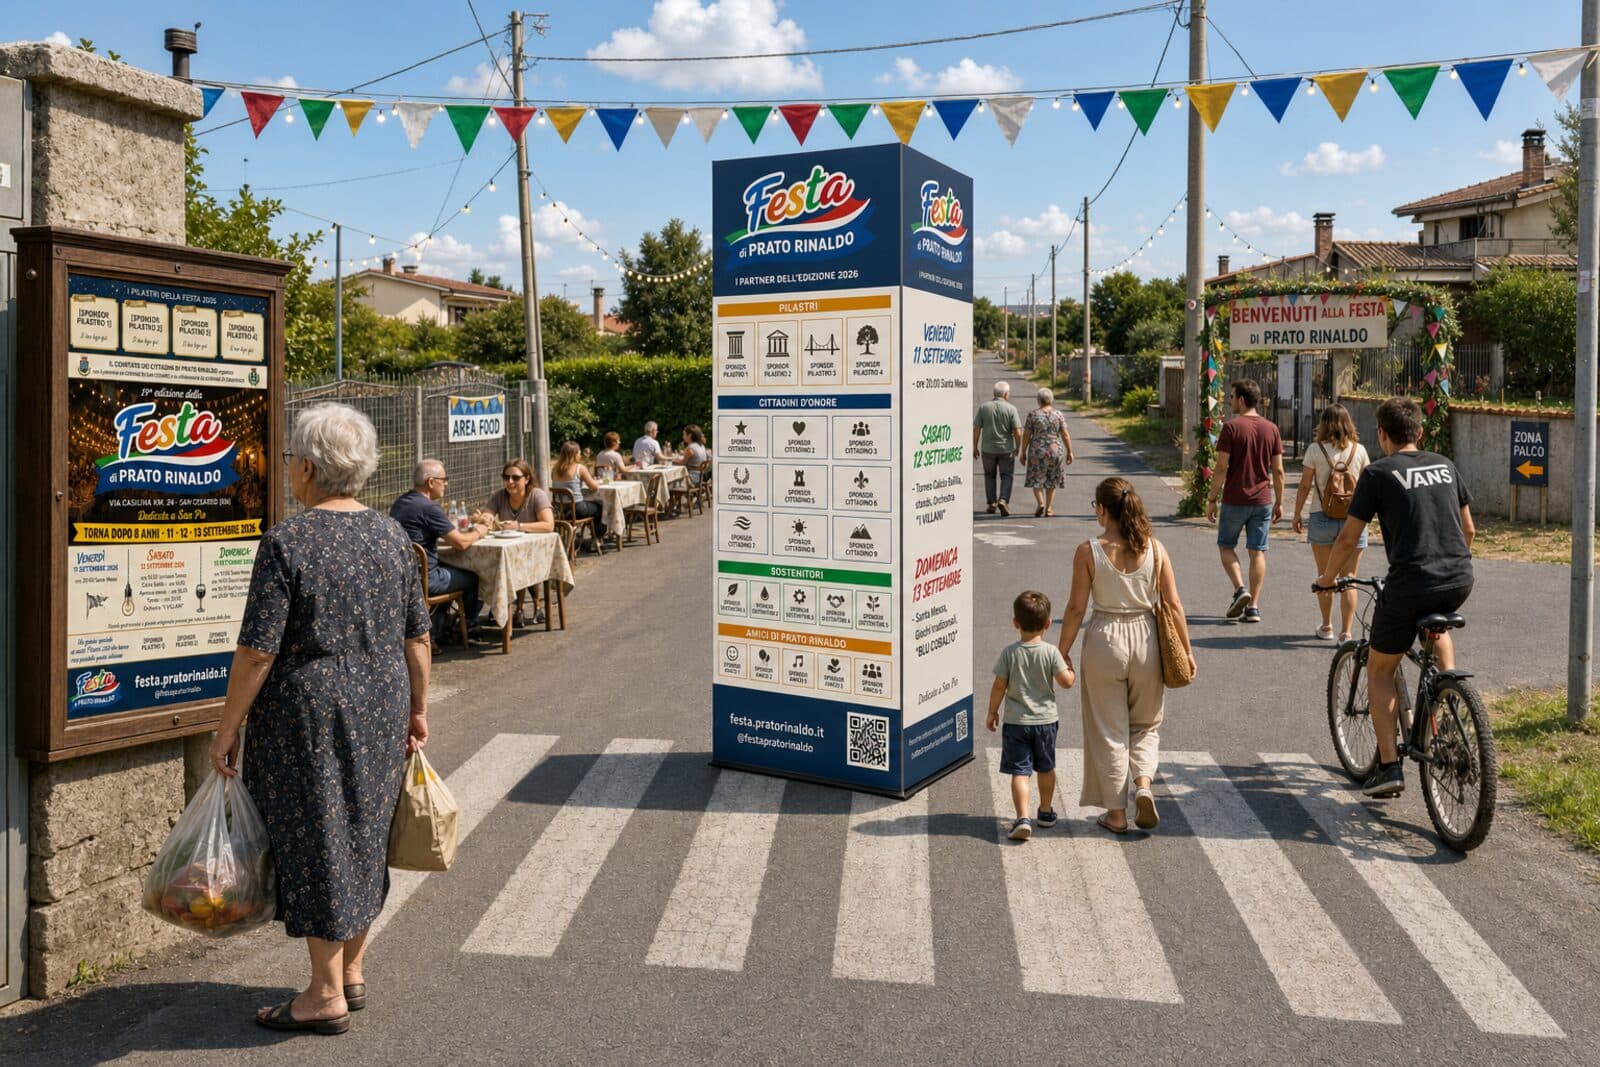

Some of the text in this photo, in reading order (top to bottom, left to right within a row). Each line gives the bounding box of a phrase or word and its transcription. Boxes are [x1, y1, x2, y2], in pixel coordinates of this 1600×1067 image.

[743, 164, 855, 236] Festa
[921, 180, 963, 229] Festa
[739, 232, 854, 258] di PRATO RINALDO
[922, 239, 962, 262] PRATO RINALDO
[740, 274, 774, 286] PARTNER
[778, 271, 836, 284] DELL'EDIZIONE
[838, 270, 858, 279] 2026
[131, 288, 159, 298] PILASTRI
[779, 303, 818, 313] PILASTRI
[1232, 302, 1385, 323] BENVENUTI ALLA FESTA
[1251, 328, 1368, 344] DI PRATO RINALDO
[913, 346, 962, 364] 11 SETTEMBRE
[759, 398, 837, 407] CITTADINI D'ONORE
[114, 401, 222, 462] Festa
[453, 418, 499, 437] AREA FOOD
[920, 424, 951, 446] SABATO
[1514, 431, 1542, 443] ZONA
[913, 446, 963, 468] 12 SETTEMBRE
[1513, 446, 1544, 457] PALCO
[110, 469, 221, 485] di PRATO RINALDO
[1392, 464, 1453, 490] VANS
[178, 509, 192, 519] San
[84, 528, 109, 539] TORNA
[112, 528, 132, 539] DOPO
[134, 528, 139, 538] 8
[141, 528, 160, 538] ANNI
[167, 528, 174, 538] 11
[180, 528, 188, 538] 12
[194, 528, 201, 537] 13
[203, 524, 239, 537] SETTEMBRE
[915, 546, 958, 579] DOMENICA
[771, 567, 824, 579] SOSTENITORI
[912, 569, 961, 602] 13 SETTEMBRE
[746, 629, 846, 648] AMICI DI PRATO RINALDO
[135, 666, 227, 688] festa.pratorinaldo.it
[729, 713, 824, 738] festa.pratorinaldo.it
[737, 733, 813, 752] @festapratorinaldo
